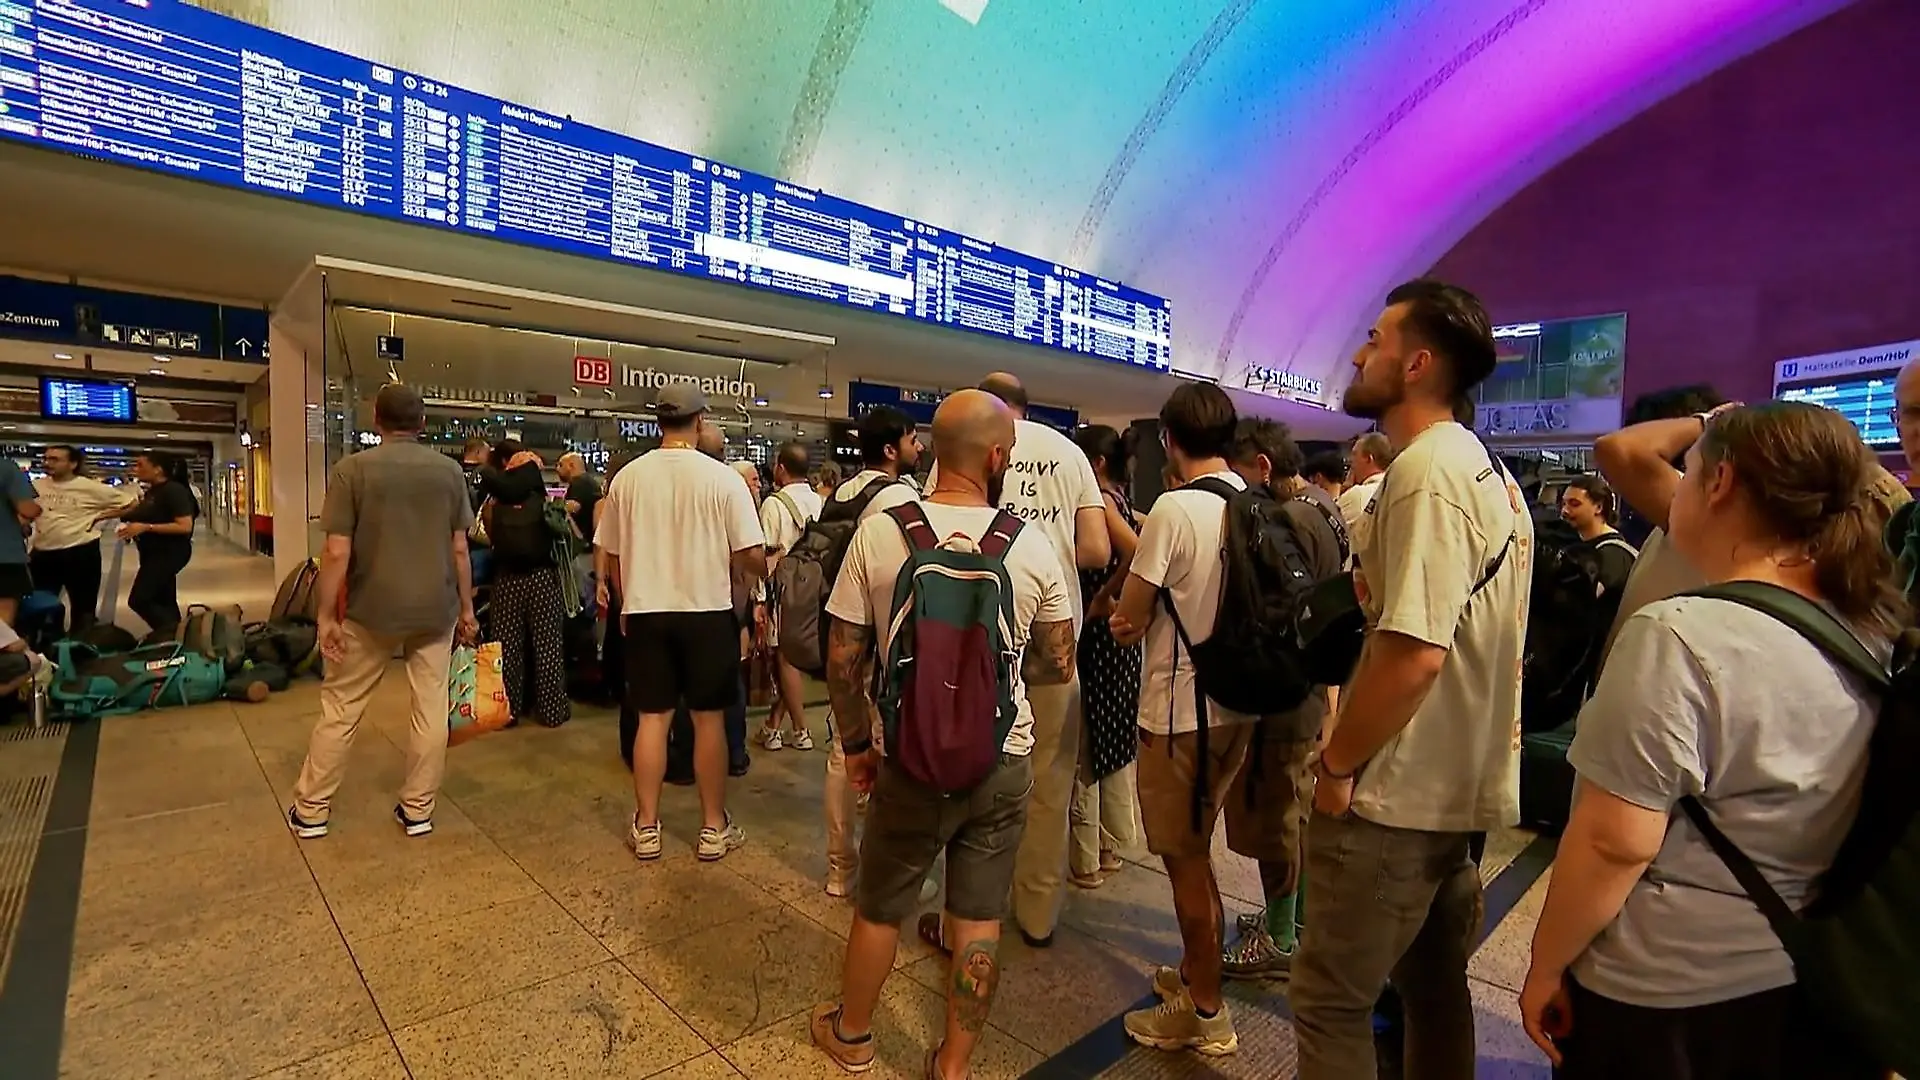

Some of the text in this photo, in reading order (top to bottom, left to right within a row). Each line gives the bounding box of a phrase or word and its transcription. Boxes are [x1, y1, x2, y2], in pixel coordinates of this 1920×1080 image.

[1858, 350, 1910, 366] Dom/Hbf
[578, 361, 609, 383] DB
[1269, 369, 1322, 395] STARBUCKS
[583, 450, 610, 465] TER
[1008, 460, 1059, 477] OUVY
[1020, 480, 1037, 497] IS
